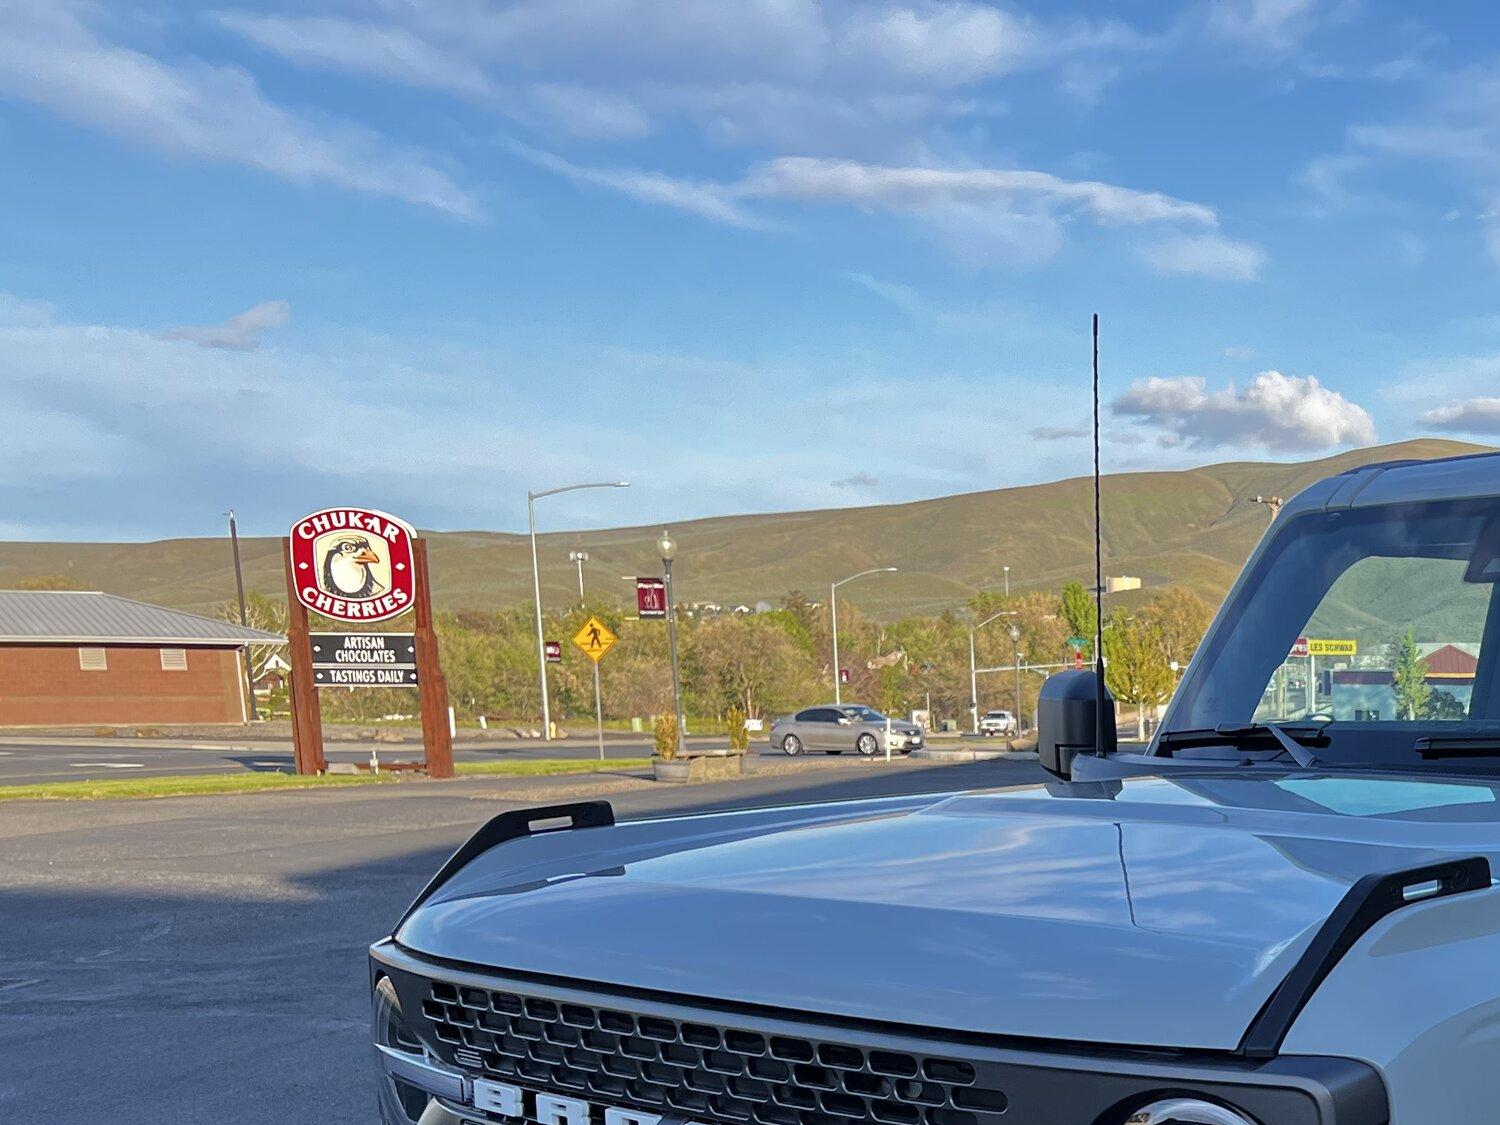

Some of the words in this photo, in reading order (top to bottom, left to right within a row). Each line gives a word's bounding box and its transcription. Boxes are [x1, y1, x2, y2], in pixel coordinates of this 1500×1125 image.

[298, 512, 400, 543] CHUKAR
[302, 587, 408, 618] CHERRIES
[344, 636, 384, 649] ARTISAN
[335, 649, 396, 663] CHOCOLATES
[330, 670, 376, 683] TASTINGS
[377, 670, 404, 683] DAILY
